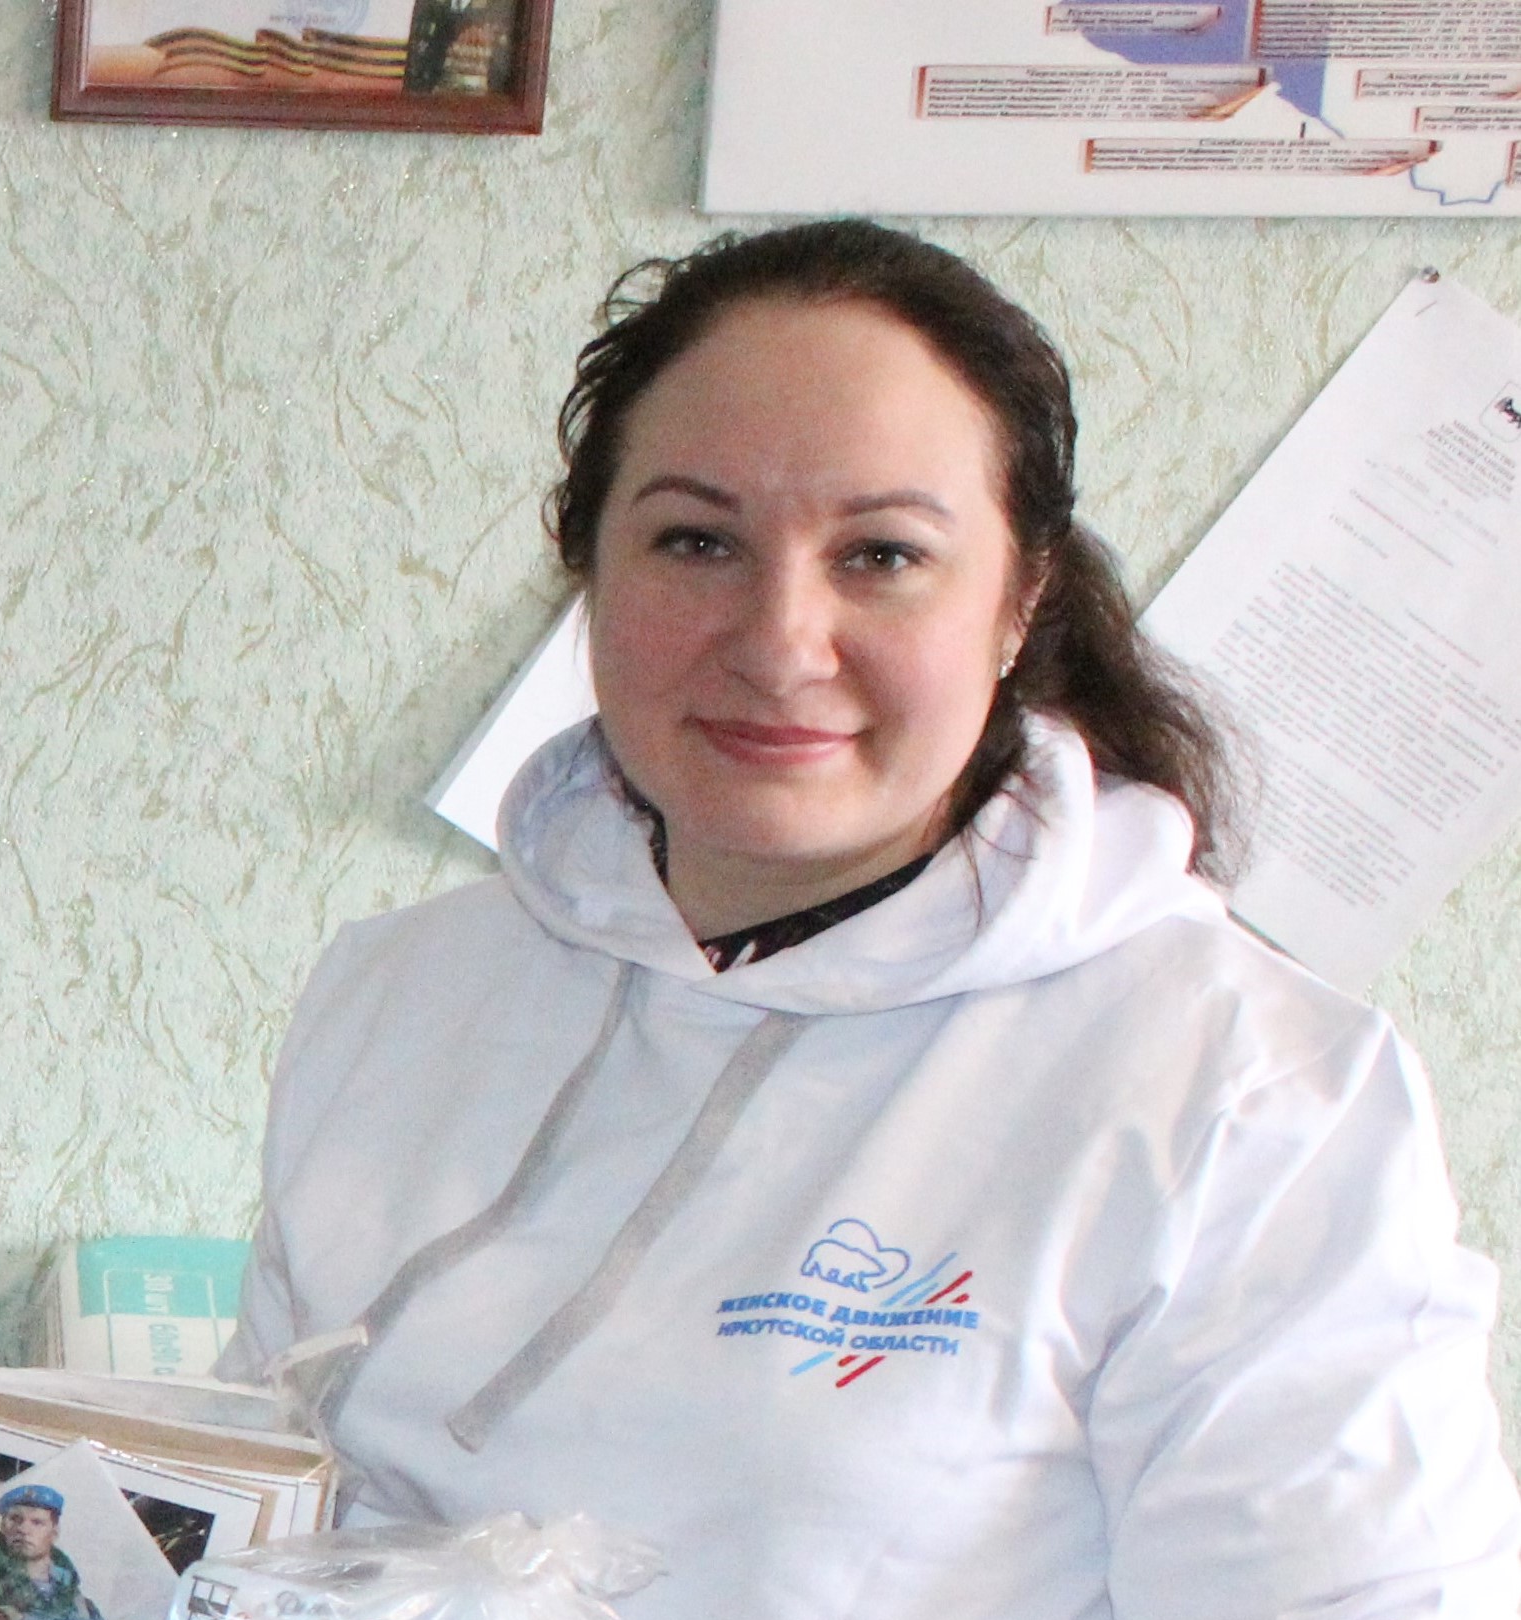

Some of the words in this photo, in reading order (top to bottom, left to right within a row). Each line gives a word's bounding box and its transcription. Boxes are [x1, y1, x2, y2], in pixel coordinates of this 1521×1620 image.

[717, 1293, 827, 1314] ЖЕНСКОЕ
[830, 1306, 979, 1330] ДВИЖЕНИЕ
[717, 1318, 846, 1347] ИРКУТСКОЙ
[848, 1334, 960, 1355] ОБЛАСТИ
